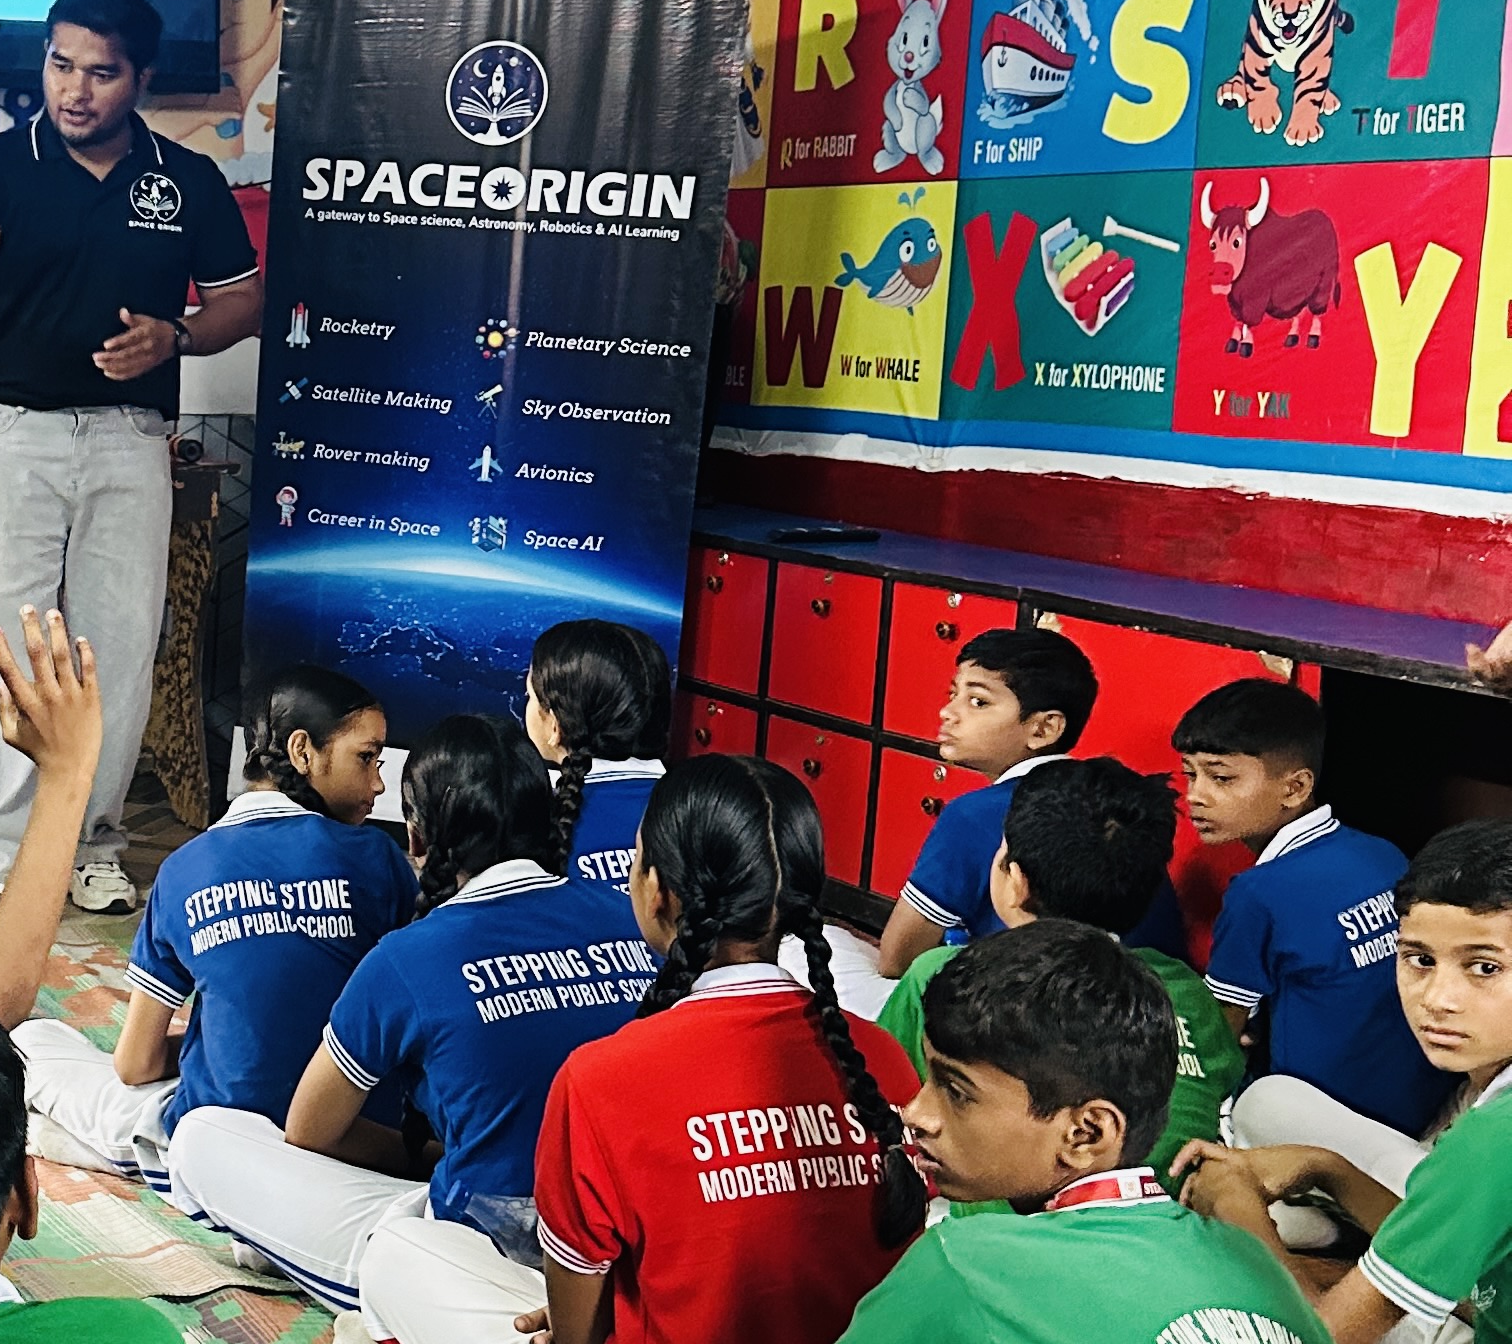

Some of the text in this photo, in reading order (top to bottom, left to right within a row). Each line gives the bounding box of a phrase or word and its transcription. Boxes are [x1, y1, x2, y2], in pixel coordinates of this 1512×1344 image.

[1373, 107, 1400, 135] for
[1406, 102, 1465, 134] TIGER
[795, 138, 811, 159] for
[813, 134, 857, 158] RABBIT
[973, 137, 1043, 164] F for SHIP
[304, 207, 680, 242] A gateway to Space science, Astronomy, Robotics & AI Learning
[950, 211, 1039, 392] X
[320, 316, 395, 340] Rocketry
[764, 286, 843, 389] W
[1354, 241, 1463, 438] Y
[525, 331, 692, 358] Planetary Science
[840, 355, 920, 383] W for WHALE
[1034, 362, 1166, 393] X for XYLOPHONE
[311, 384, 453, 415] Satellite Making
[522, 400, 671, 425] Sky Observation
[1213, 389, 1226, 416] Y
[1229, 391, 1252, 417] for
[313, 444, 430, 472] Rover making
[515, 462, 594, 485] Avionics
[307, 508, 441, 537] Career in Space
[523, 530, 605, 552] Space AI
[185, 878, 352, 928] STEPPING STONE
[190, 910, 357, 956] MODERN PUBLIC SCHOOL
[461, 940, 658, 994] STEPPING STONE
[476, 980, 619, 1024] MODERN PUBLIC
[686, 1103, 842, 1162] STEPPING
[698, 1160, 796, 1203] MODERN
[798, 1154, 869, 1190] PUBLIC
